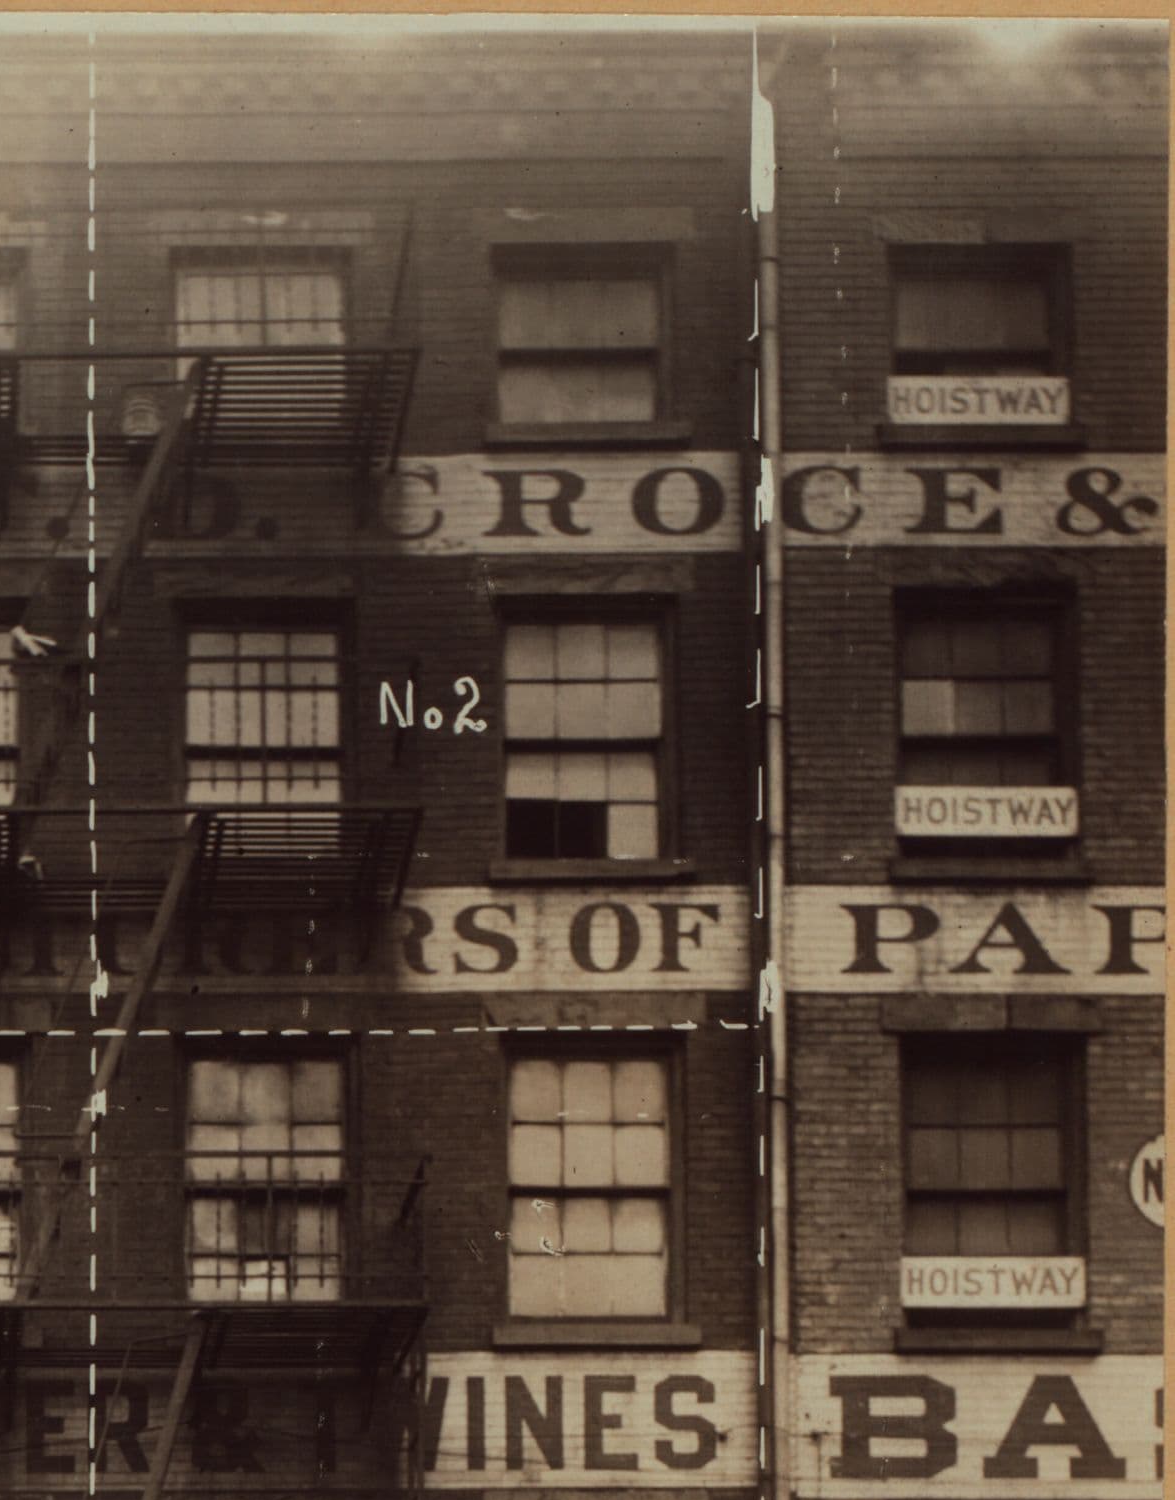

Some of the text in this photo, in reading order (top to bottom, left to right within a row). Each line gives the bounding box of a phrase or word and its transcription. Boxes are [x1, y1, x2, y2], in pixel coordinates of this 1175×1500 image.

[890, 385, 1065, 415] HOISTWAY
[1056, 466, 1160, 537] &
[902, 796, 1074, 826] HOISTWAY
[568, 902, 720, 975] OF
[906, 1266, 1080, 1297] HOISTWAY
[828, 1374, 1164, 1480] BA
